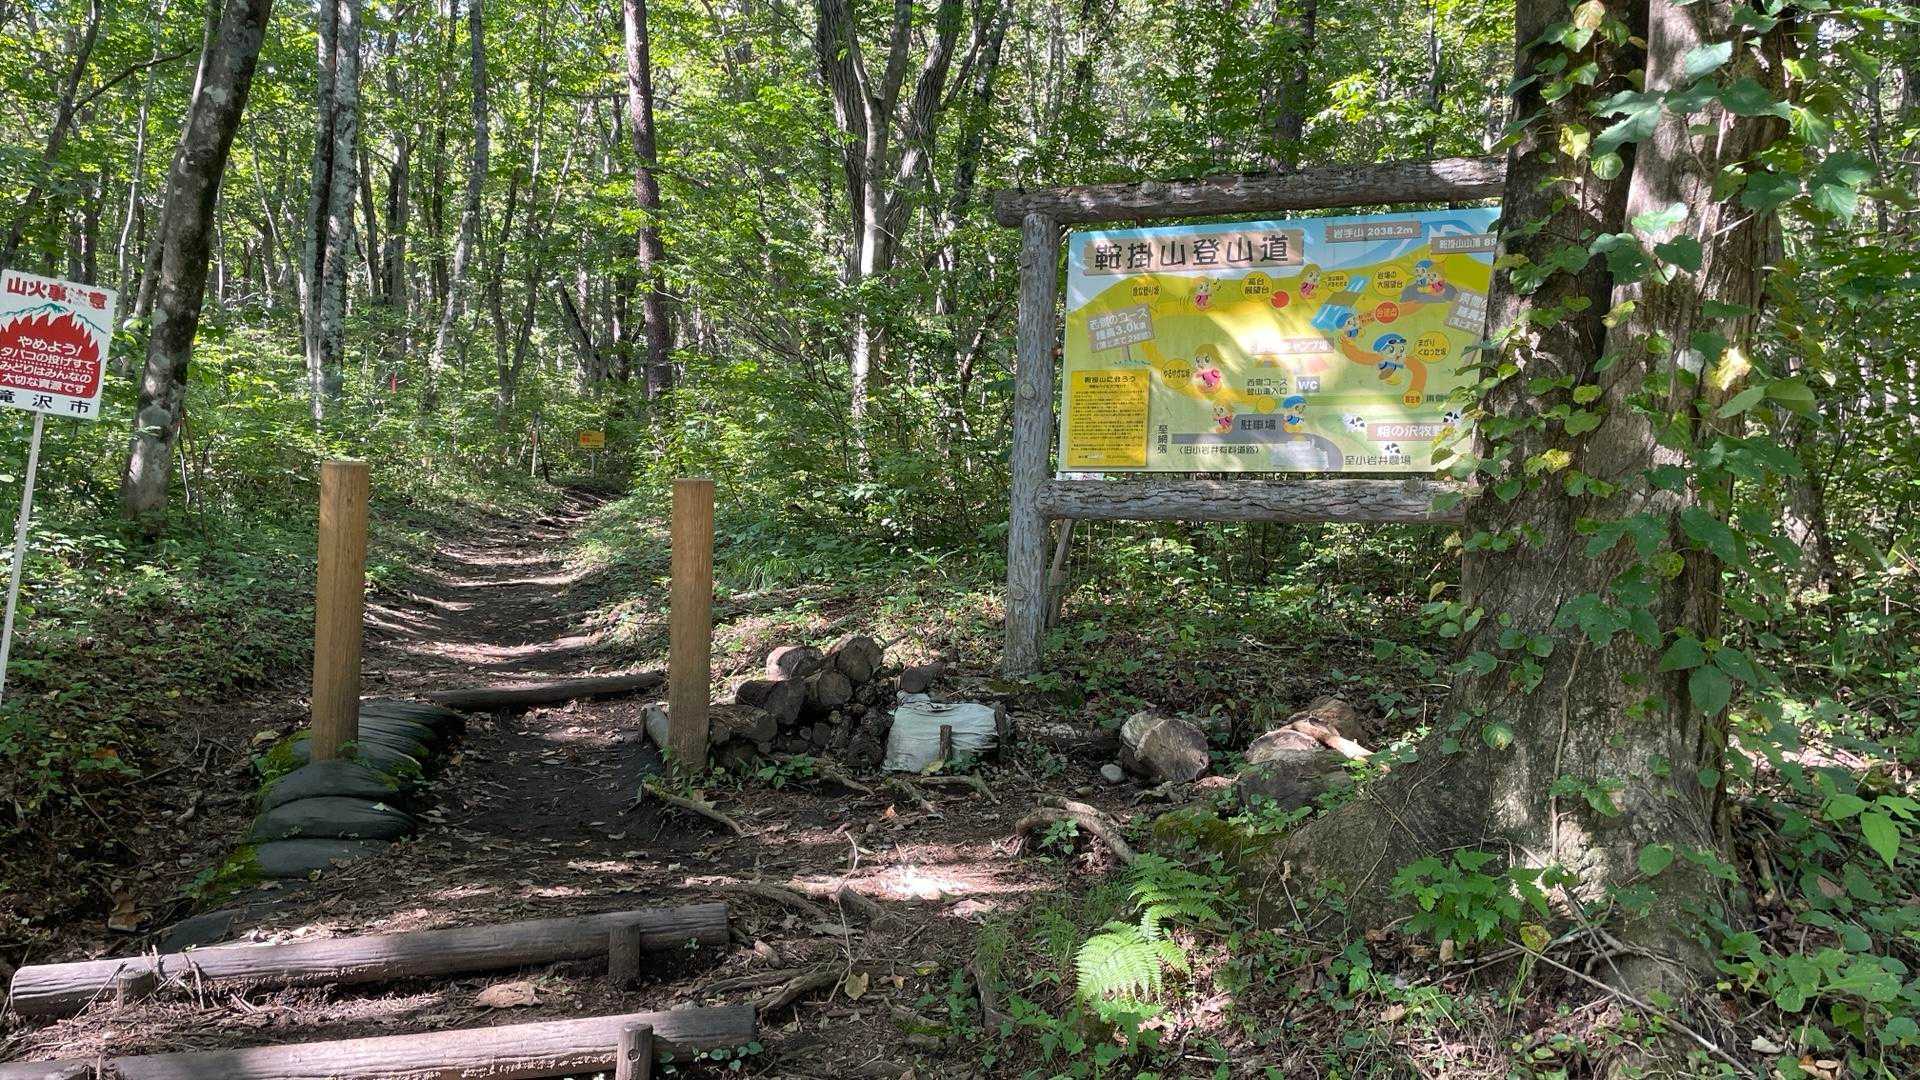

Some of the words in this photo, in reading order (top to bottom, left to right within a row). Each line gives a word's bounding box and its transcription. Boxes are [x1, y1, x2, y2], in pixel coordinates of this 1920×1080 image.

[1367, 226, 1413, 237] 2038.2m
[1094, 234, 1289, 270] 鞍掛山登山道
[1, 347, 97, 371] タバコの投げすて
[0, 360, 93, 384] みどりはみんなの
[2, 373, 87, 394] 大切な資源です
[1298, 380, 1318, 391] WC
[1241, 419, 1277, 431] 駐車場
